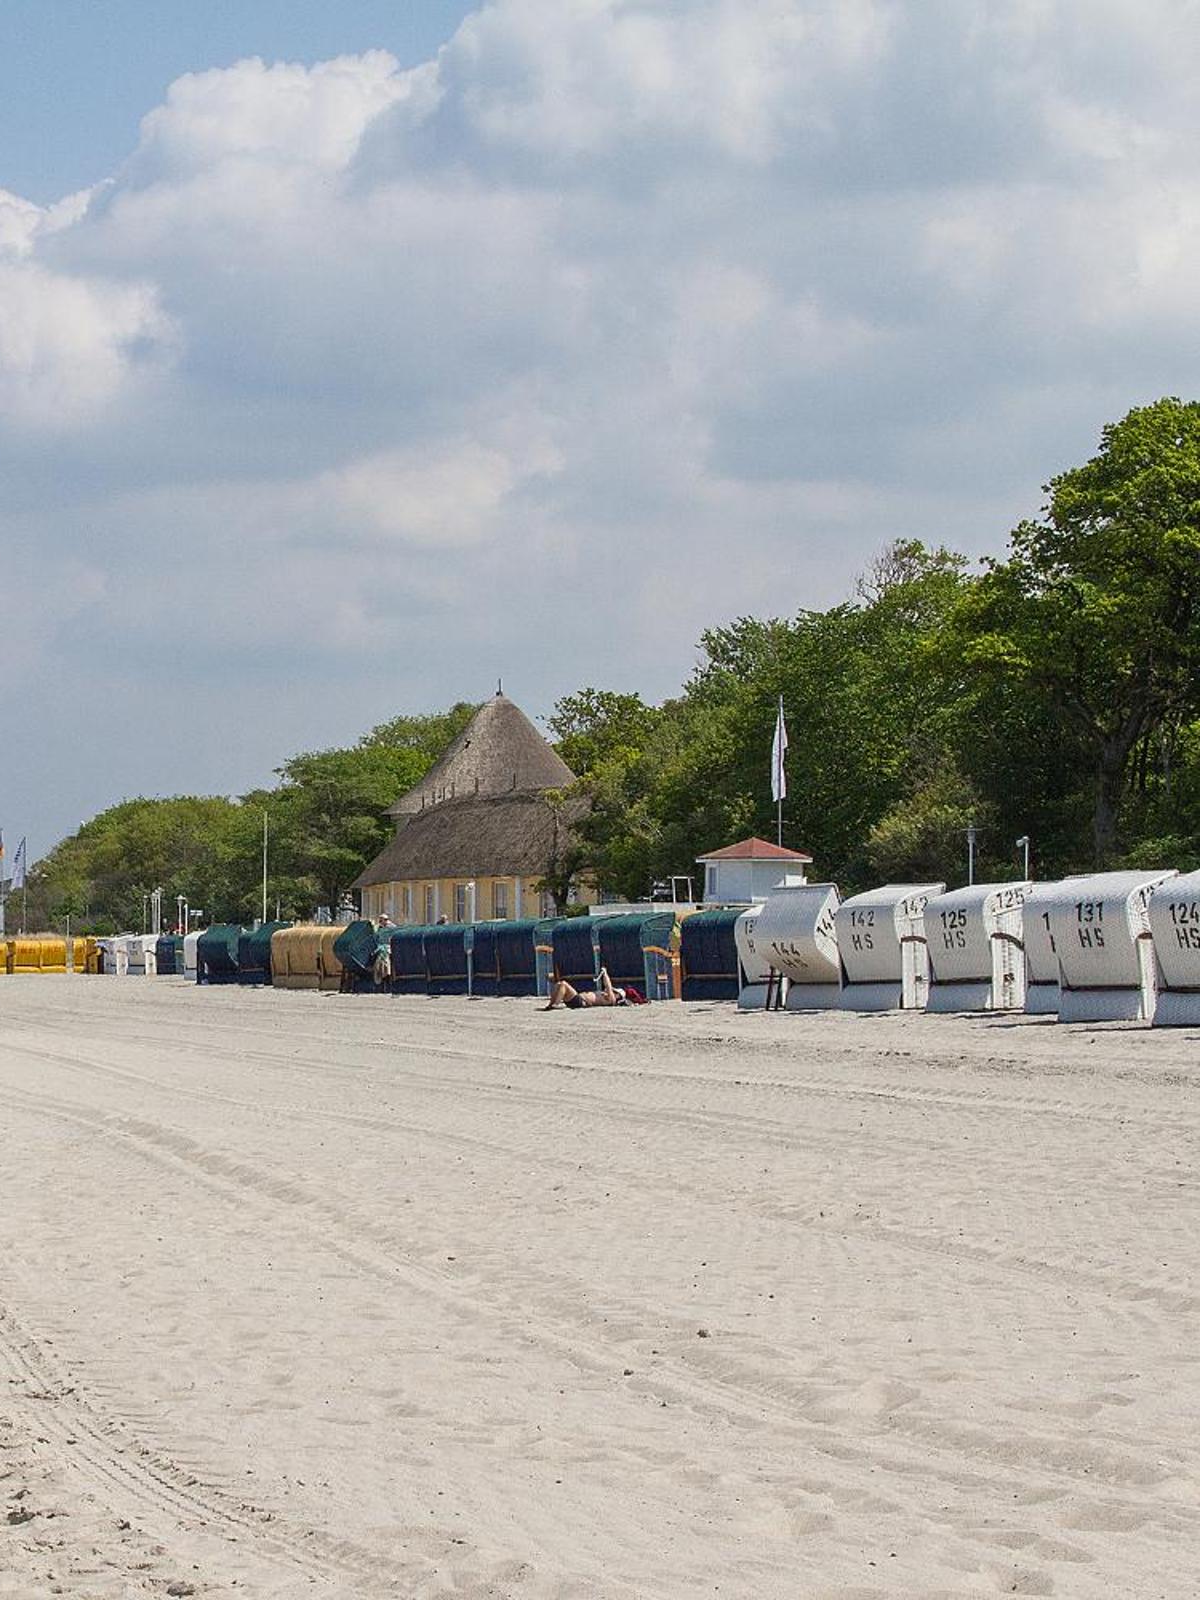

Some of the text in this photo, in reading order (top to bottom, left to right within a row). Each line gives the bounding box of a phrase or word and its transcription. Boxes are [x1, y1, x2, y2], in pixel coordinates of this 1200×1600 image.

[901, 896, 929, 915] 142
[996, 888, 1025, 908] 125
[851, 910, 875, 927] 142
[940, 909, 967, 929] 125
[1075, 901, 1104, 922] 131
[1169, 902, 1200, 924] 124
[852, 934, 873, 950] HS
[943, 930, 966, 949] HS
[1078, 928, 1105, 948] HS
[1175, 928, 1200, 949] HS
[772, 942, 801, 957] 144
